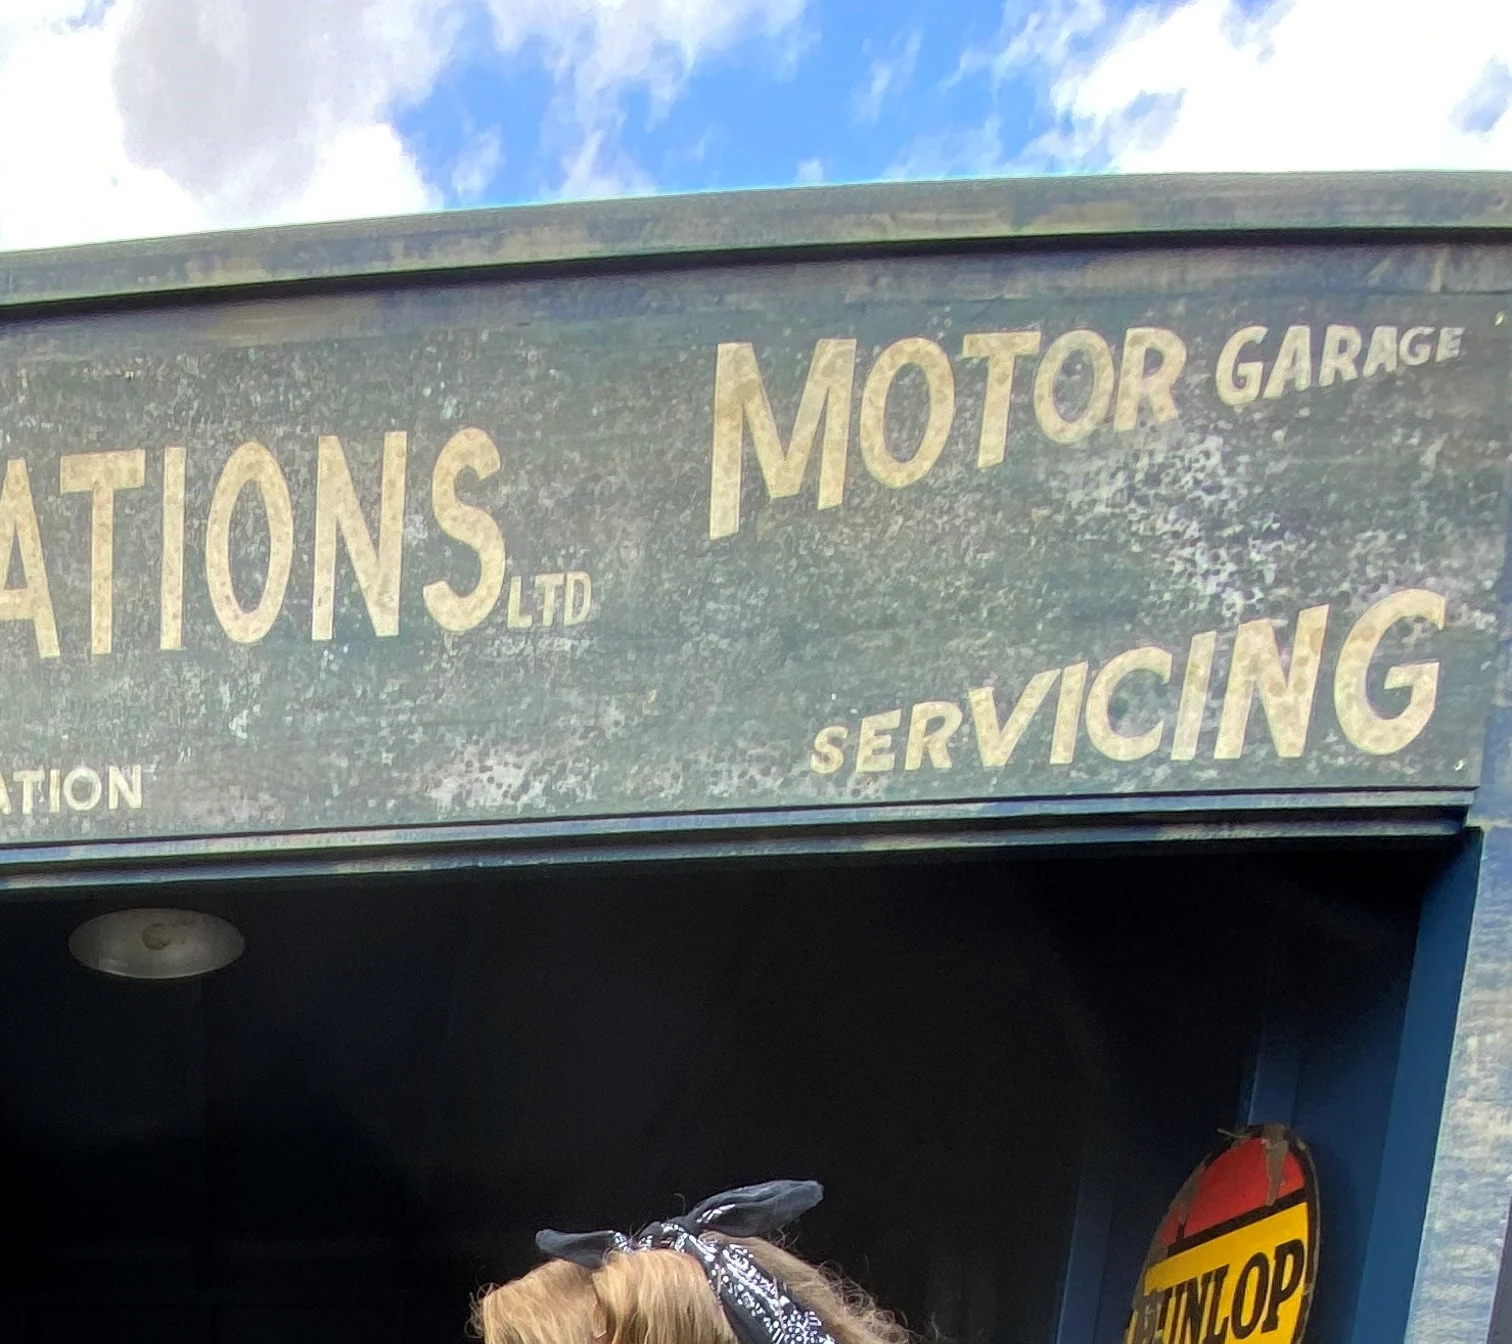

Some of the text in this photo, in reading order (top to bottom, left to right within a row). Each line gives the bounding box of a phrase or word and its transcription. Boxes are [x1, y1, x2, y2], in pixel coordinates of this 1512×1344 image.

[708, 324, 1465, 540] MOTOR GARAGE
[506, 571, 594, 630] LTD
[810, 588, 1448, 776] SERVICING
